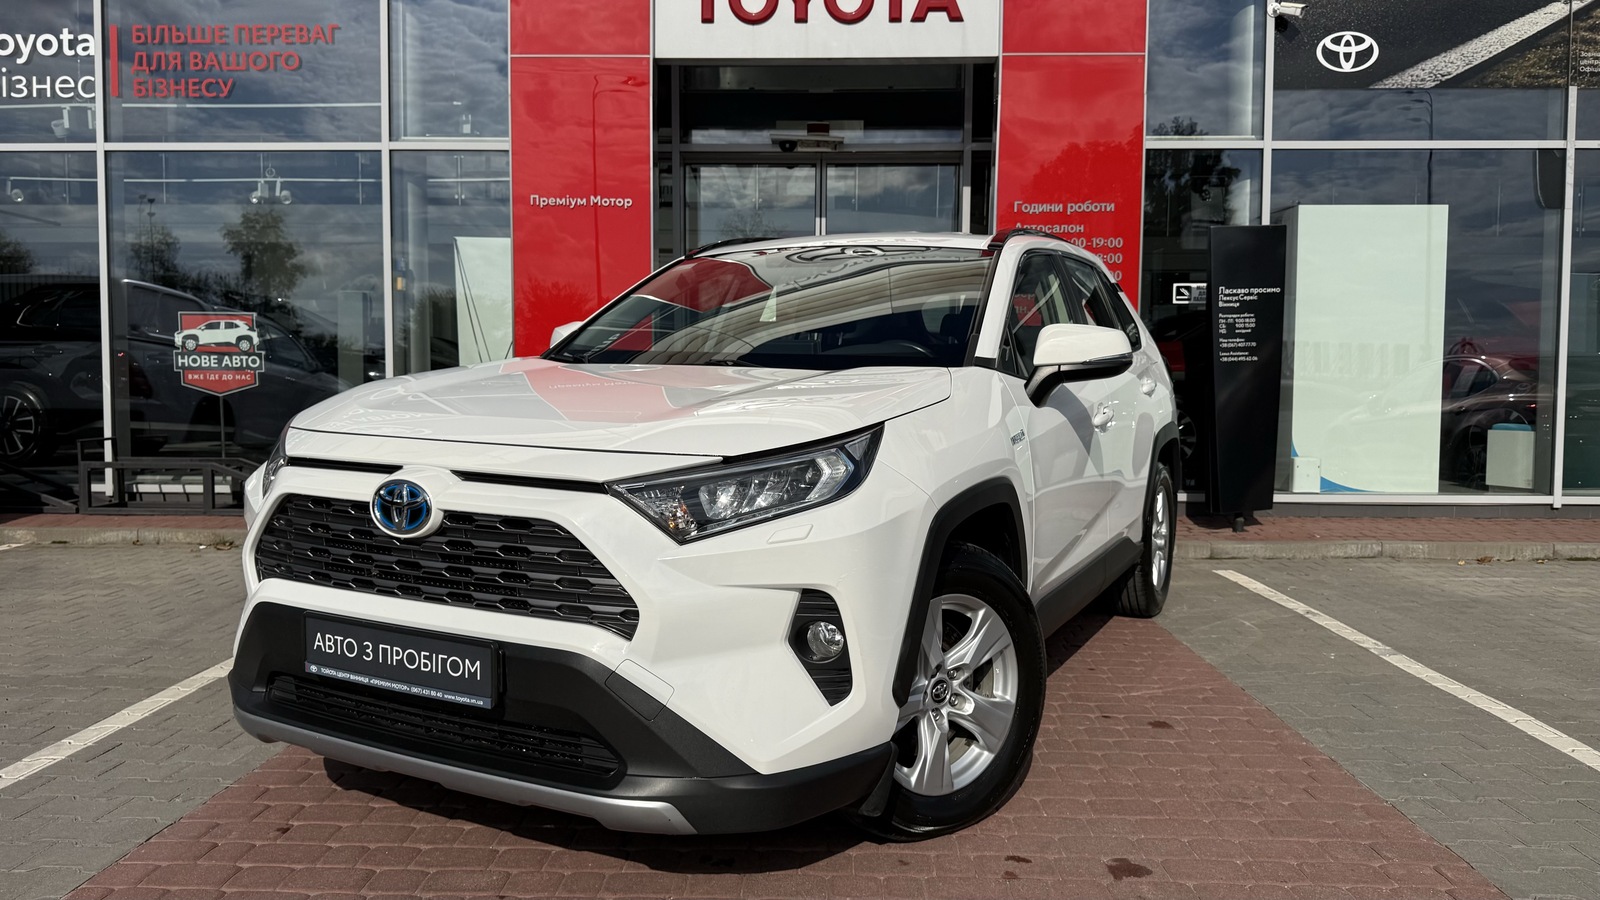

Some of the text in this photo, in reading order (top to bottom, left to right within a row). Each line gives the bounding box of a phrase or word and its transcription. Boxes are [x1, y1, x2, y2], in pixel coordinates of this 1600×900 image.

[132, 24, 339, 44] БІЛЬШЕ ПЕРЕВАГ
[131, 52, 300, 72] ДЛЯ ВАШОГО
[134, 78, 234, 97] БІЗНЕСУ
[530, 194, 632, 208] Преміум Мотор
[1014, 200, 1114, 215] Години роботи
[178, 355, 260, 368] НОВЕ АВТО
[313, 632, 480, 680] АВТО З ПРОБІГОМ
